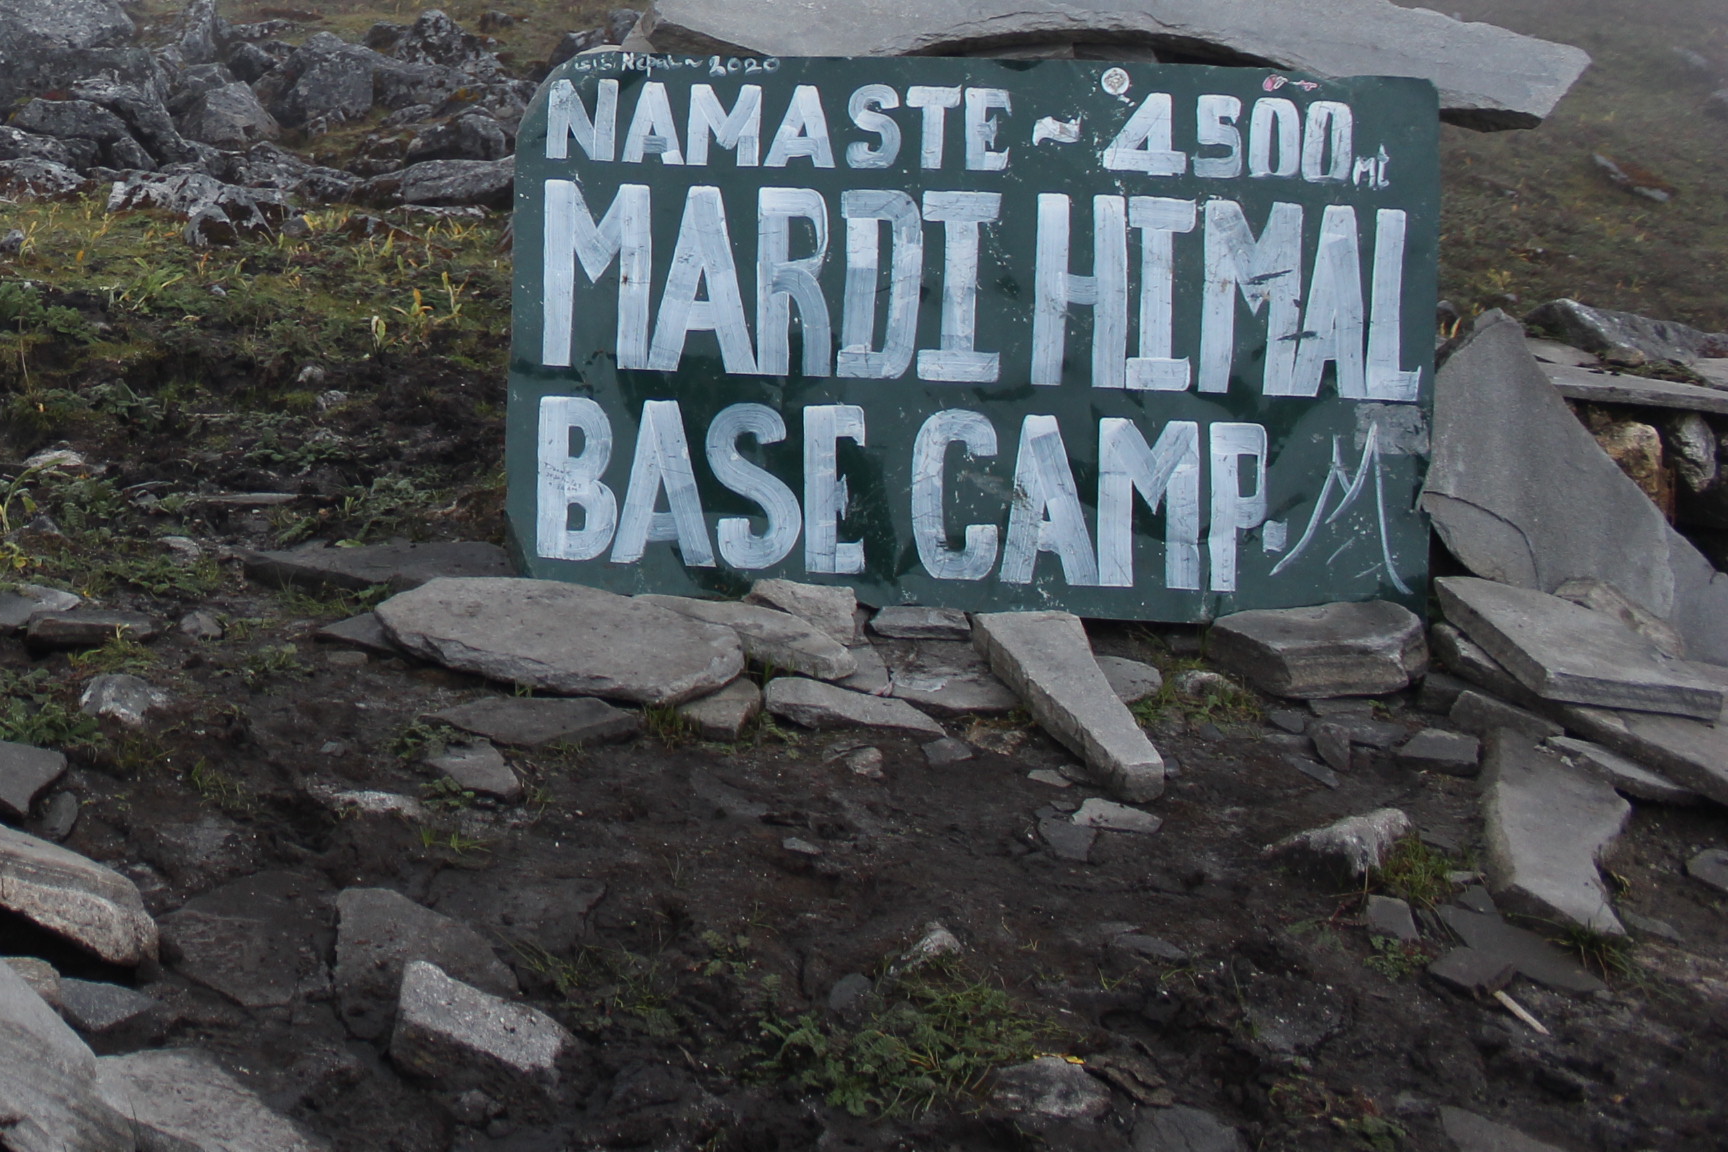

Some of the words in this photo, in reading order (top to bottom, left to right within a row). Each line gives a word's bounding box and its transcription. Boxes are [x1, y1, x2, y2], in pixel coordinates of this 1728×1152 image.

[544, 78, 1013, 172] NAMASTE
[708, 54, 782, 78] 2020
[541, 178, 1003, 384] MARDI
[1029, 191, 1423, 402] HIMAL
[535, 395, 867, 575] BASE
